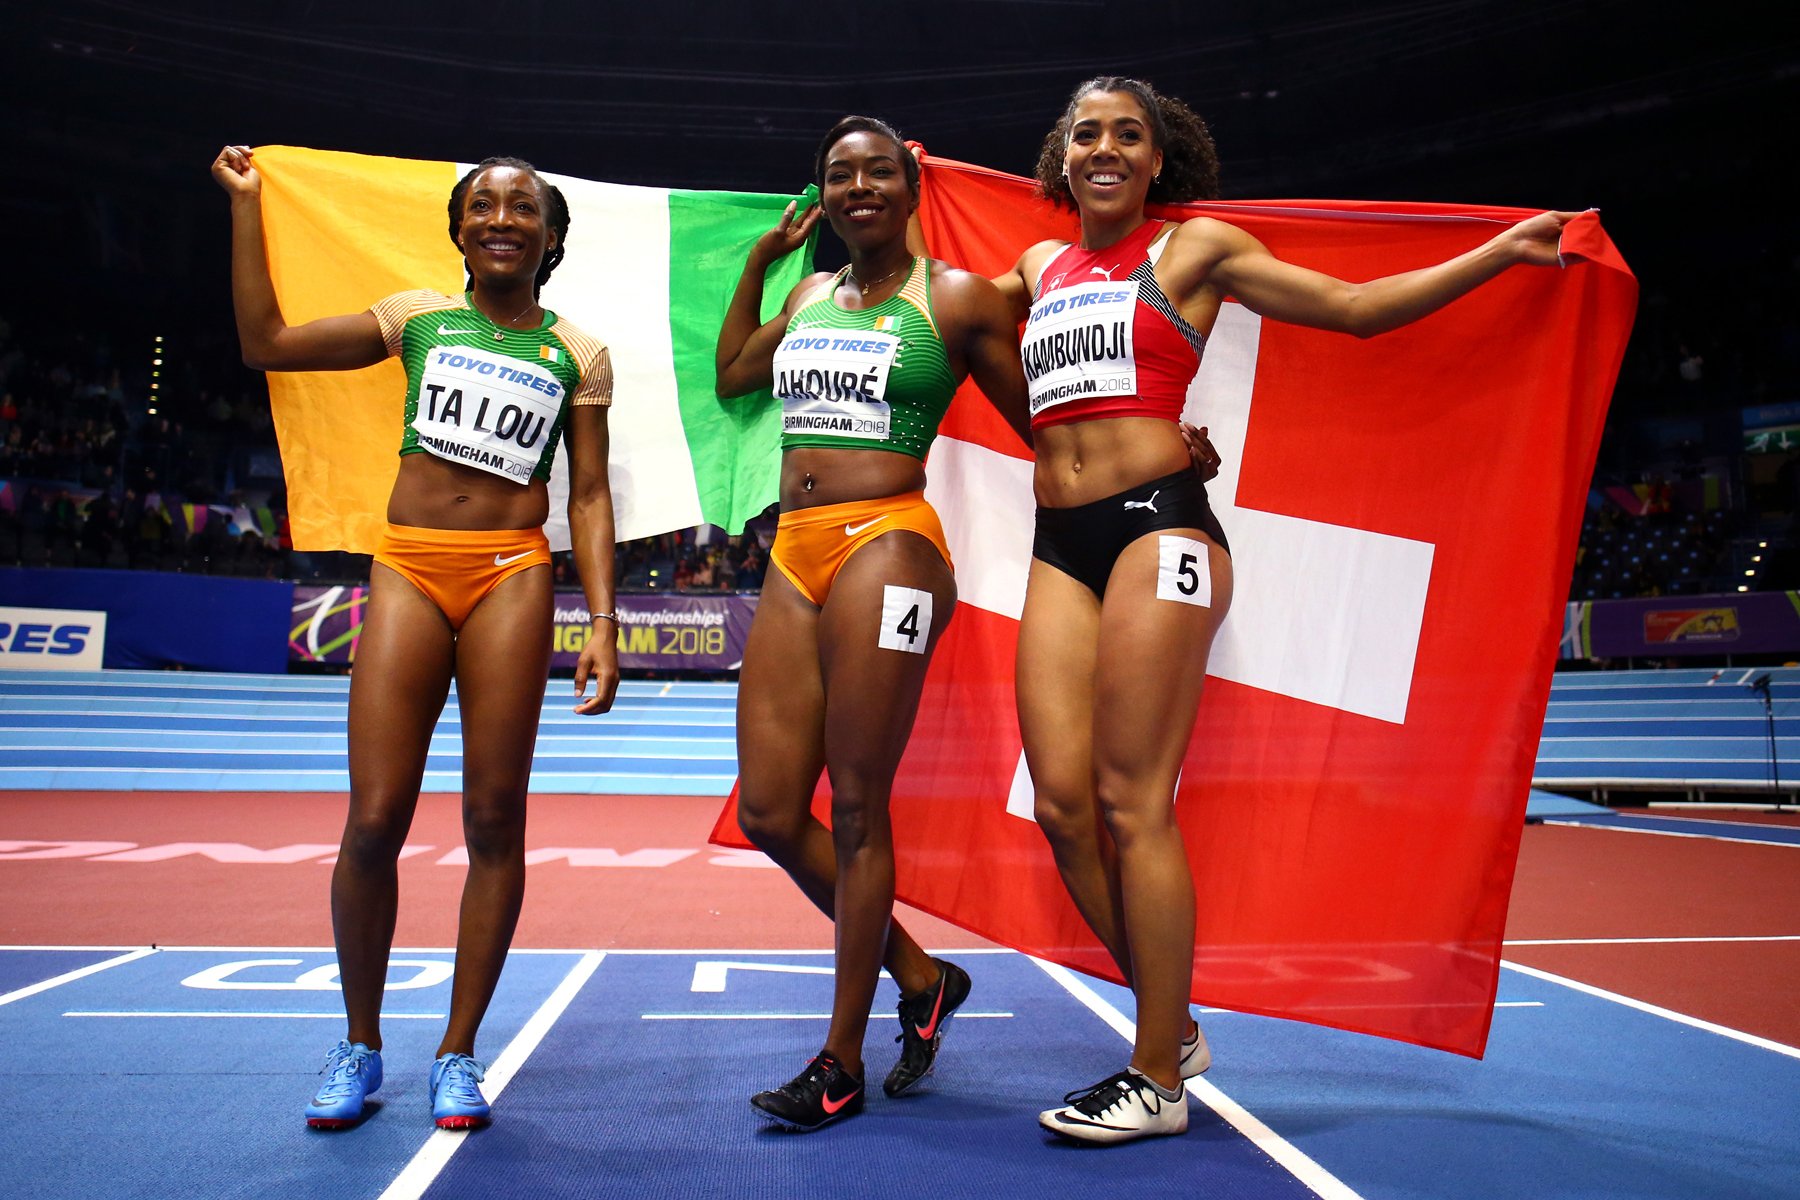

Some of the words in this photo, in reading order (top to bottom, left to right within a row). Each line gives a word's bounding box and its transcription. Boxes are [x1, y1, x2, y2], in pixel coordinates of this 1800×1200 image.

[1030, 300, 1066, 325] TOYO
[1069, 291, 1130, 310] TIRES
[783, 338, 830, 352] TOYO
[832, 339, 890, 355] TIRES
[1023, 321, 1126, 382] KAMBUNDJI
[437, 352, 496, 376] TOYO
[498, 366, 561, 398] TIRES
[778, 366, 882, 404] AHOURÉ
[1032, 379, 1097, 411] BIRMINGHAM
[1099, 377, 1131, 392] 2018
[426, 383, 463, 427] TA
[474, 397, 546, 449] LOU
[784, 415, 852, 431] BIRMINGHAM
[854, 419, 886, 433] 2018
[504, 459, 533, 481] 2018
[1176, 552, 1199, 596] 5
[616, 607, 724, 627] hampionships
[896, 604, 919, 645] 4
[661, 627, 726, 655] 2018
